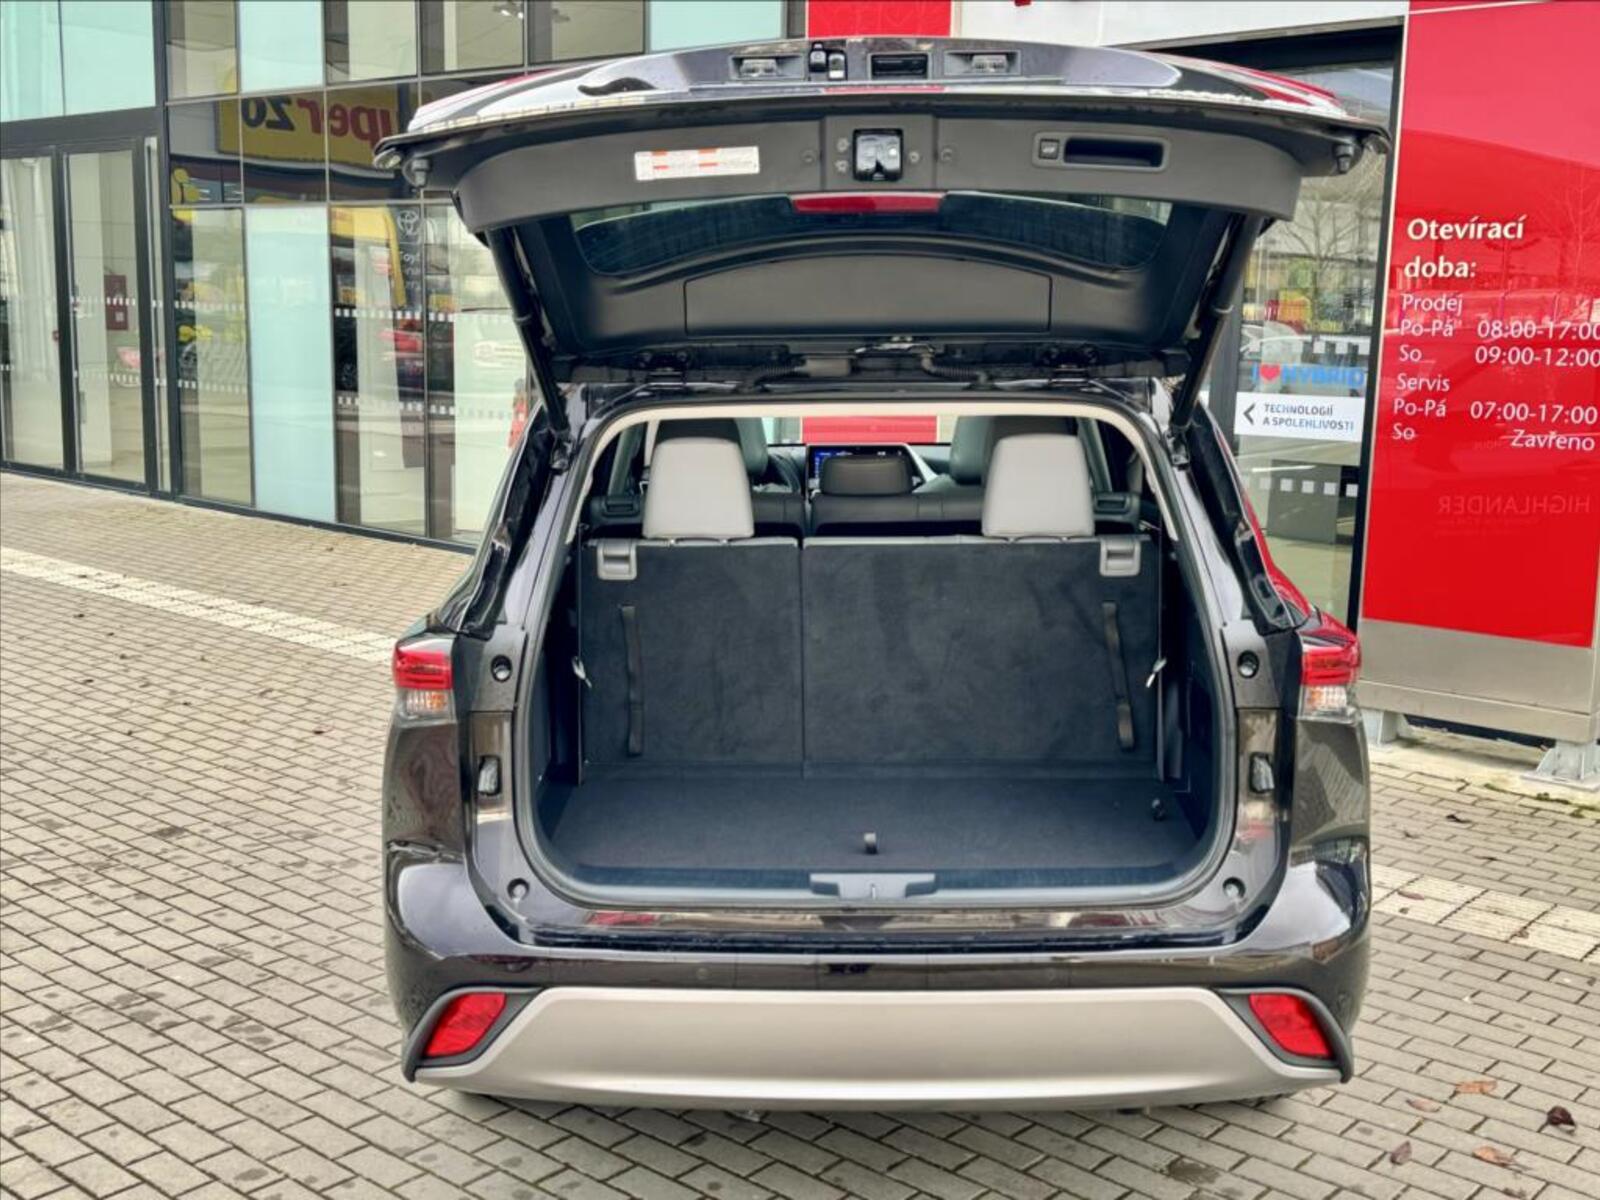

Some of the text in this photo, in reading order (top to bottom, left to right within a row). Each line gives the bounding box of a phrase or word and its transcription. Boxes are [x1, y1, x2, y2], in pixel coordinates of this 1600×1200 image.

[1407, 215, 1527, 240] Otevírací
[1404, 256, 1477, 279] doba:
[1401, 293, 1463, 316] Prodej
[1399, 319, 1600, 341] Po-Pá 08:00-17:00
[1399, 344, 1600, 367] So 09:00-12:00
[1396, 373, 1450, 392] Servis
[1264, 403, 1334, 417] TECHNOLOGIÍ
[1393, 398, 1598, 425] Po-Pá 07:00-17:00
[1262, 416, 1355, 431] A SPOLEHLIVOSTI
[1393, 422, 1415, 440] So
[1510, 428, 1596, 451] Zavřeno
